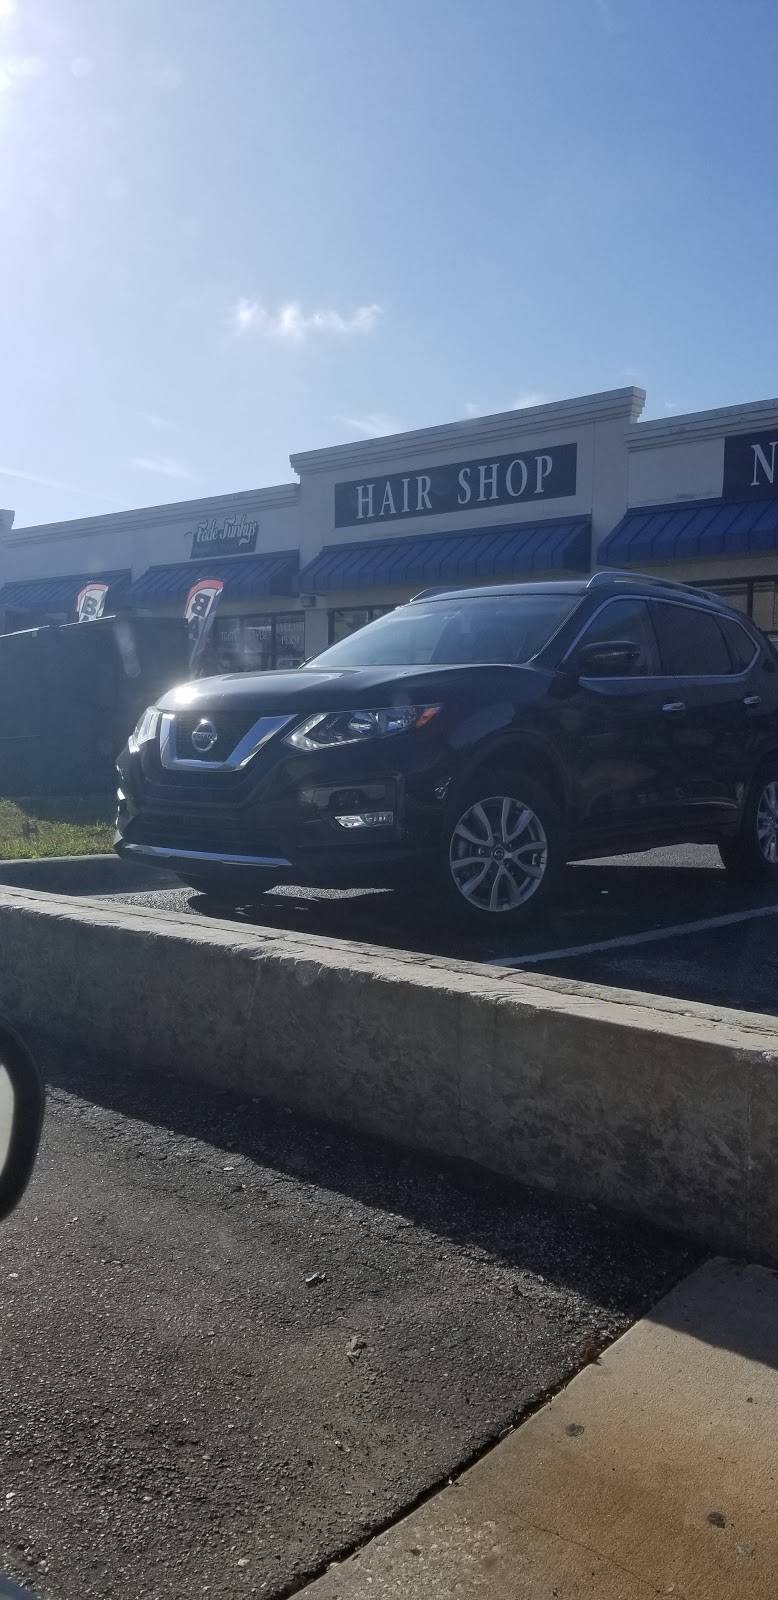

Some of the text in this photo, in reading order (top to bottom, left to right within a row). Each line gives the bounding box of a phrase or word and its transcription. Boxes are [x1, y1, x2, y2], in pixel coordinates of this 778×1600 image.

[751, 442, 778, 486] N
[356, 455, 553, 519] HAIR SHOP
[196, 518, 218, 543] Fade
